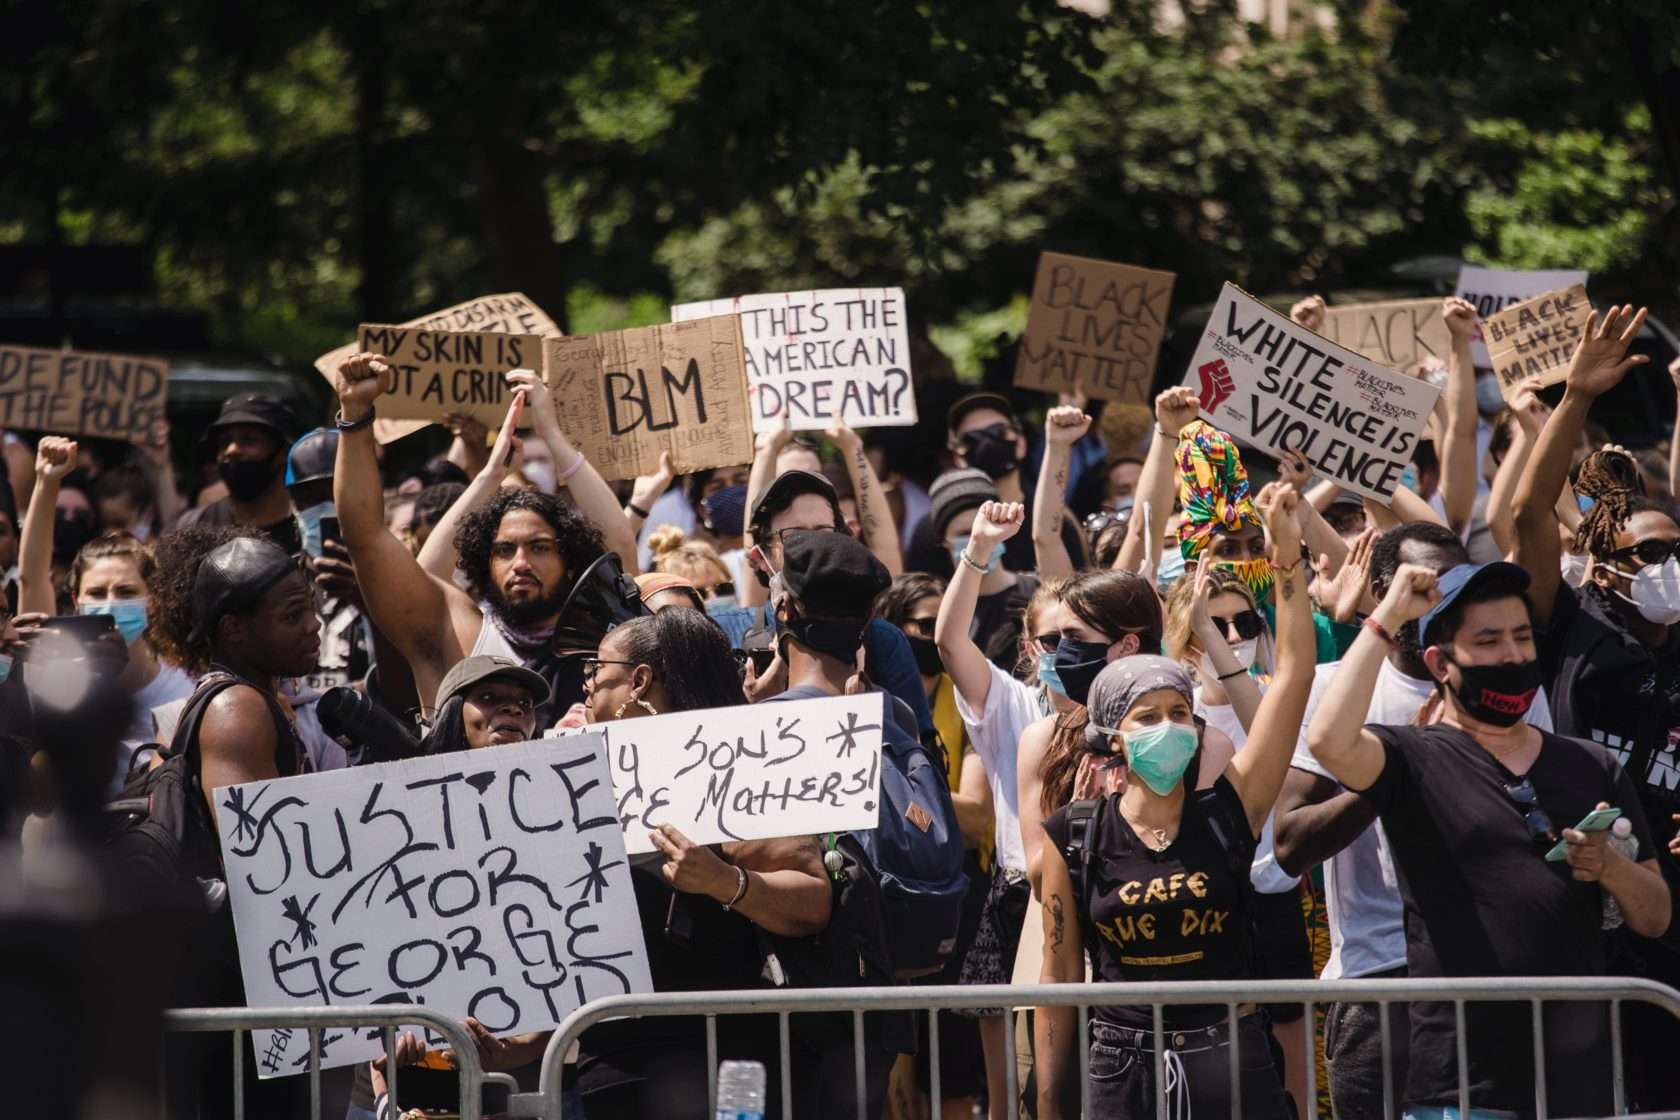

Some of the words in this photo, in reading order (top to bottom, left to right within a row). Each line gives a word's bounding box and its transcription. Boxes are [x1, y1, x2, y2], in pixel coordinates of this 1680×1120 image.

[742, 302, 829, 339] THIS
[834, 299, 899, 330] THE
[1040, 263, 1168, 327] BLACK
[1490, 293, 1578, 342] BLACK
[363, 329, 408, 356] MY
[413, 333, 484, 364] SKIN
[497, 336, 523, 367] IS
[743, 337, 896, 377] AMERICAN
[1057, 310, 1154, 358] LIVES
[1226, 300, 1345, 392] WHITE
[1513, 316, 1579, 354] LIVES
[1017, 342, 1150, 400] MATTER
[1500, 337, 1583, 387] MATTE
[0, 391, 80, 430] THE
[420, 372, 445, 404] A
[604, 357, 707, 437] BLM
[758, 368, 909, 419] DREAM?
[1256, 366, 1384, 444] SILENCE
[1380, 425, 1415, 454] IS
[1250, 394, 1406, 497] VIOLENCE
[674, 717, 805, 780] SON'S
[230, 752, 620, 895] JUSTICE
[332, 843, 562, 925] FOR
[1118, 871, 1209, 905] CAFE
[1181, 908, 1230, 937] DIX
[268, 902, 634, 1008] GEORGE
